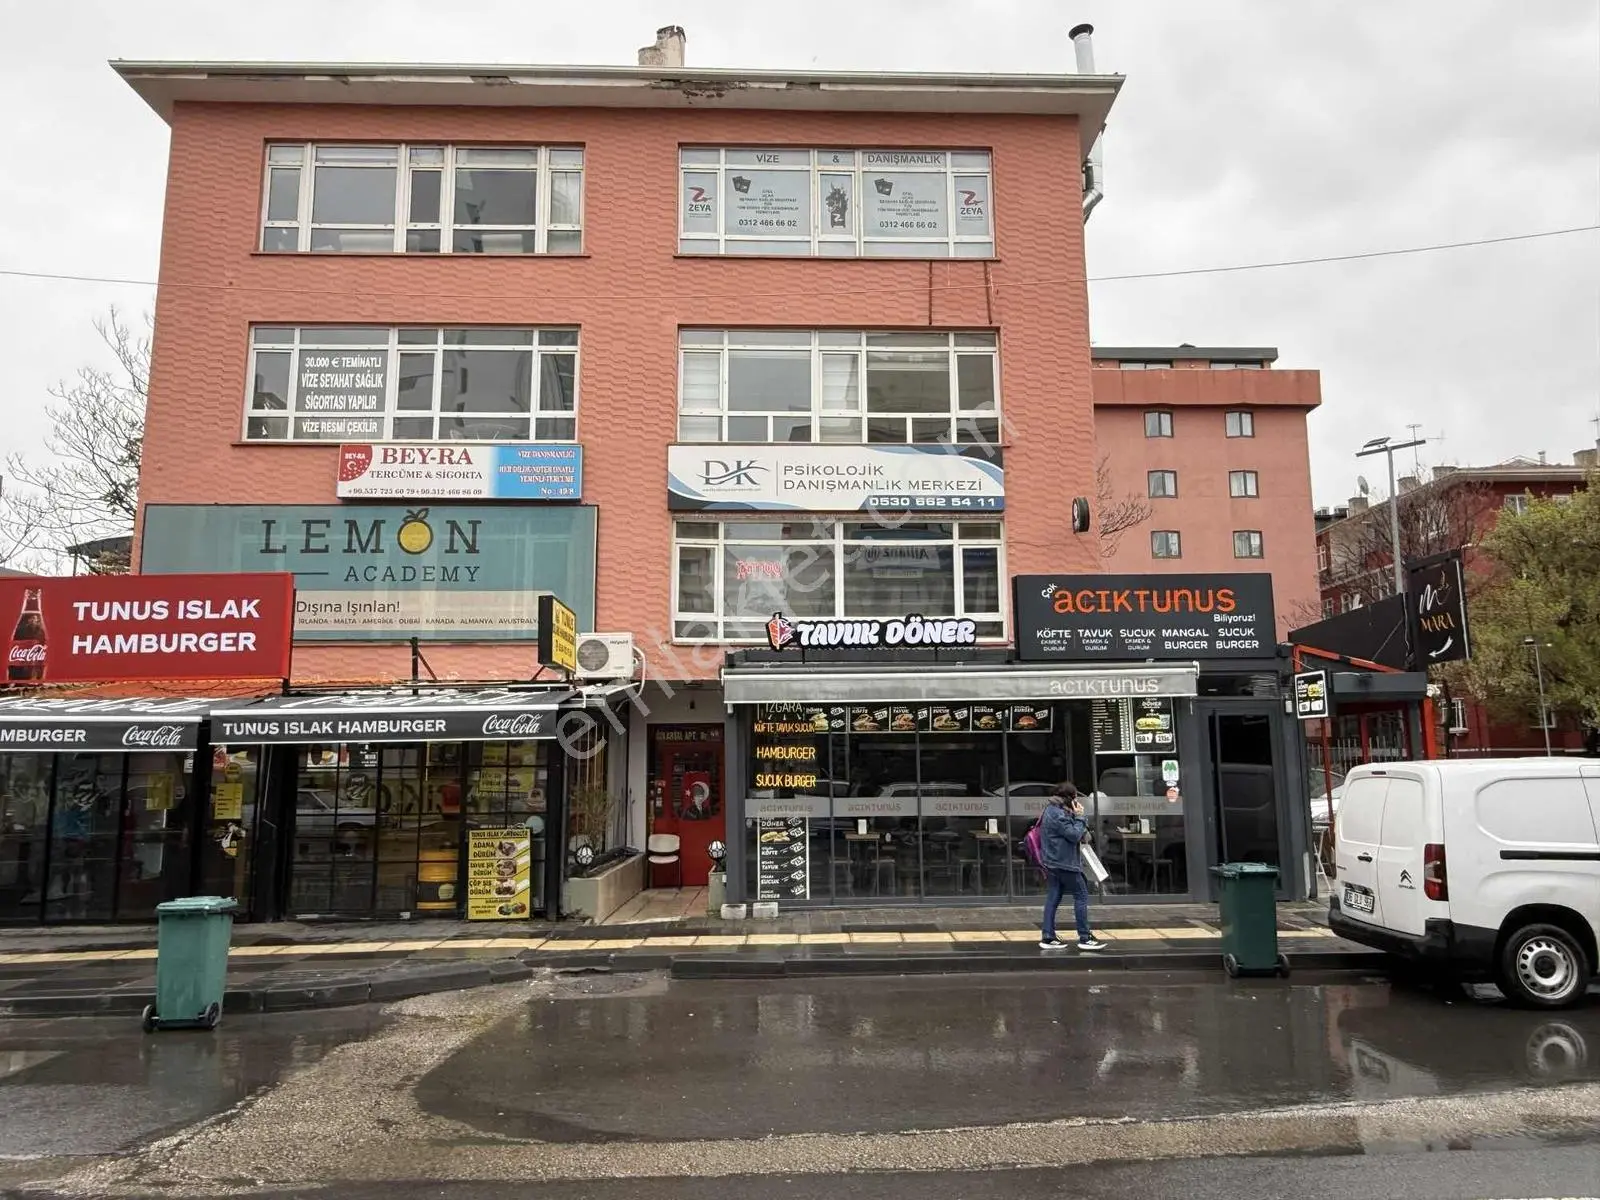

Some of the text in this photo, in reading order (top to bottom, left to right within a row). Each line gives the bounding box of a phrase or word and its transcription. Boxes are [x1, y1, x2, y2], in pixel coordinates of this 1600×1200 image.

[756, 153, 941, 165] VİZE & DANIŞMANLIK
[688, 204, 712, 212] ZEYA
[960, 207, 984, 215] ZEYA
[927, 221, 937, 229] 02
[305, 354, 382, 368] 30.000 € TEMİNATLI
[302, 369, 384, 388] VİZE SEYAHAT SAĞLIK
[305, 391, 377, 410] SİGORTASI YAPILIR
[302, 419, 320, 433] VİZE
[381, 447, 473, 465] BEY-RA
[370, 469, 483, 480] TERCÜME & SİGORTA
[784, 464, 884, 476] PSİKOLOJİK
[784, 478, 982, 493] DANIŞMANLIK MERKEZİ
[869, 497, 995, 507] 0530 662 54 11
[259, 507, 482, 556] LEMON
[344, 565, 481, 582] ACADEMY
[73, 599, 261, 621] TUNUS ISLAK
[296, 601, 400, 616] Dışına Işınlan!
[1213, 613, 1256, 624] Biliyoruz!
[797, 615, 976, 646] TAVUK DÖNER
[1036, 627, 1255, 639] KÖFTE TAVUK SUCUK MANGAL SUCUK
[72, 632, 256, 655] HAMBURGER
[1164, 639, 1259, 650] BURGER BURGER
[223, 713, 542, 736] TUNUS ISLAK HAMBURGER Coca-Cola
[754, 720, 815, 733] KÖFTE TAVUK SUCUK
[121, 725, 186, 746] Coca-Cola
[756, 746, 816, 760] HAMBURGER
[756, 774, 816, 787] SUCUK BURGER
